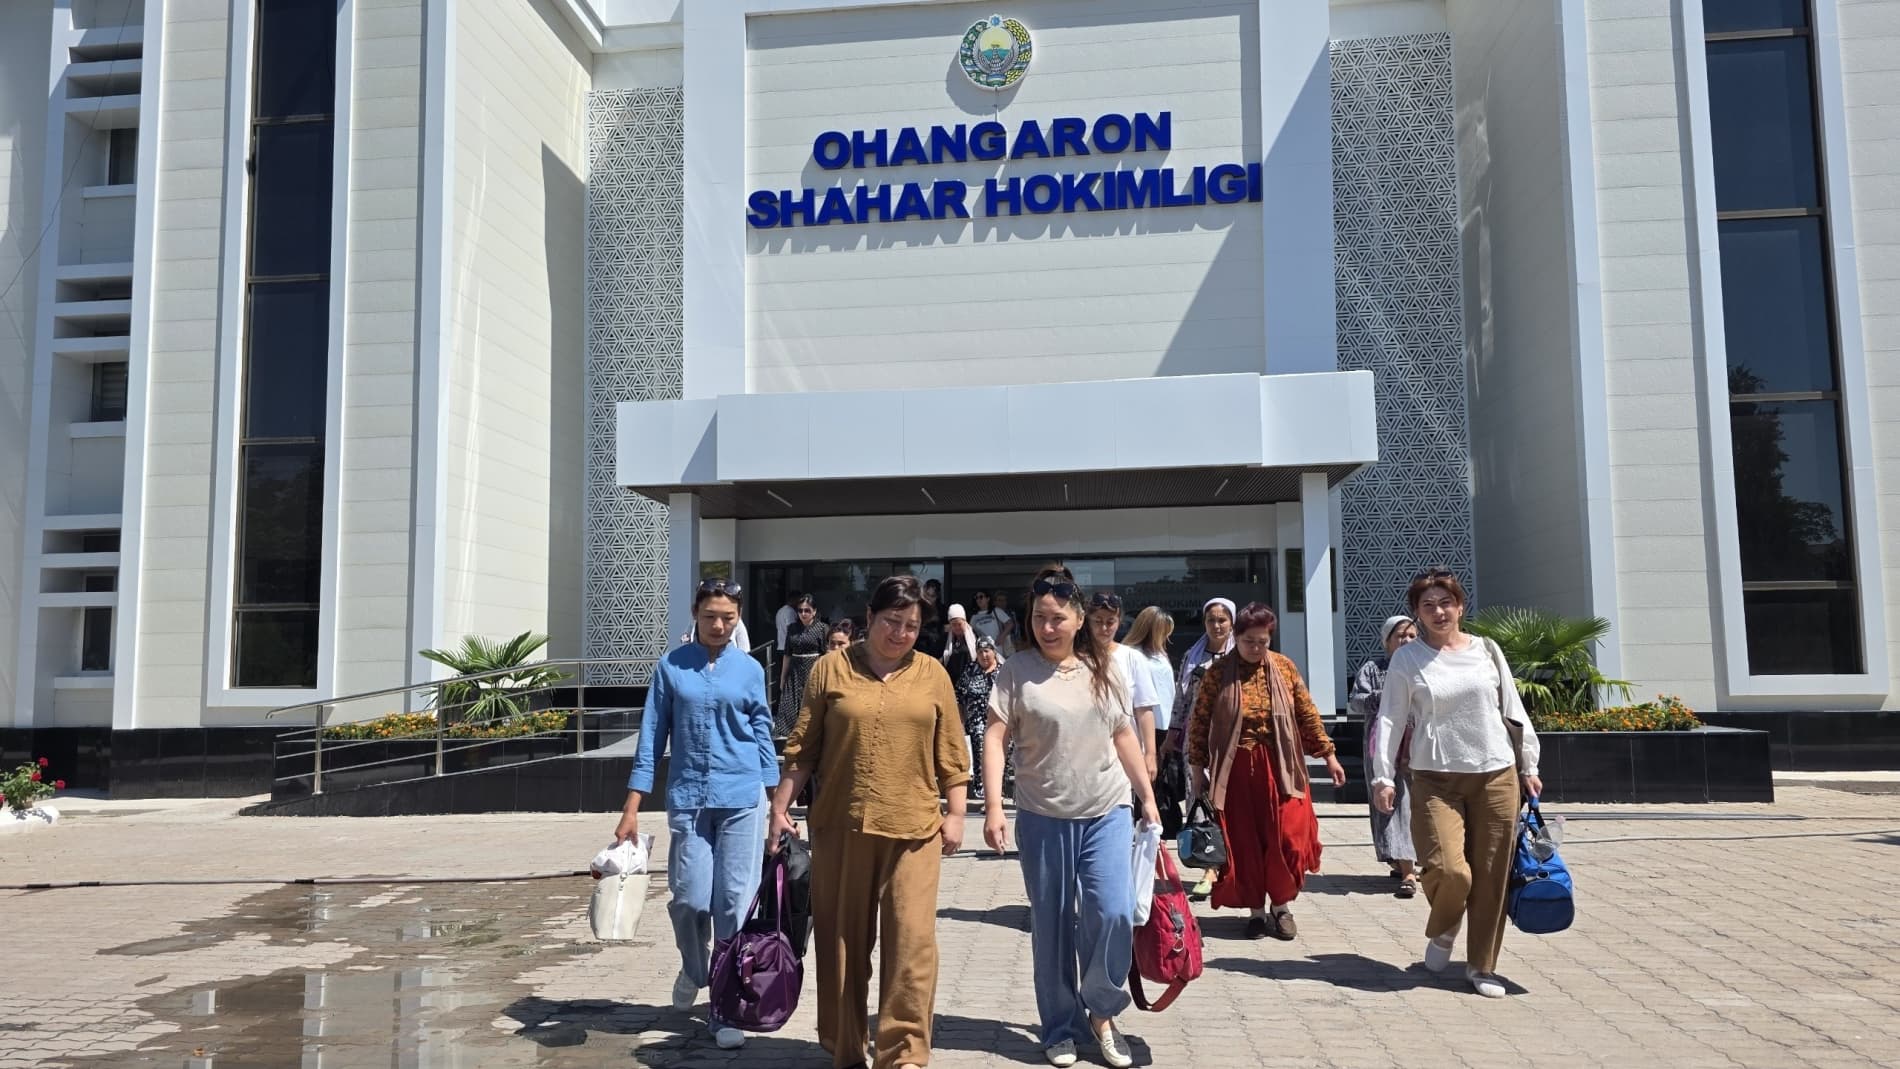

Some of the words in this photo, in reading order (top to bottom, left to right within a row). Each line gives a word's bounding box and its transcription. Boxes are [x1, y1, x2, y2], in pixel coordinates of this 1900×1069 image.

[813, 111, 1171, 171] OHANGARON
[747, 181, 968, 228] SHAHAR
[985, 163, 1262, 216] HOKIMLIGI
